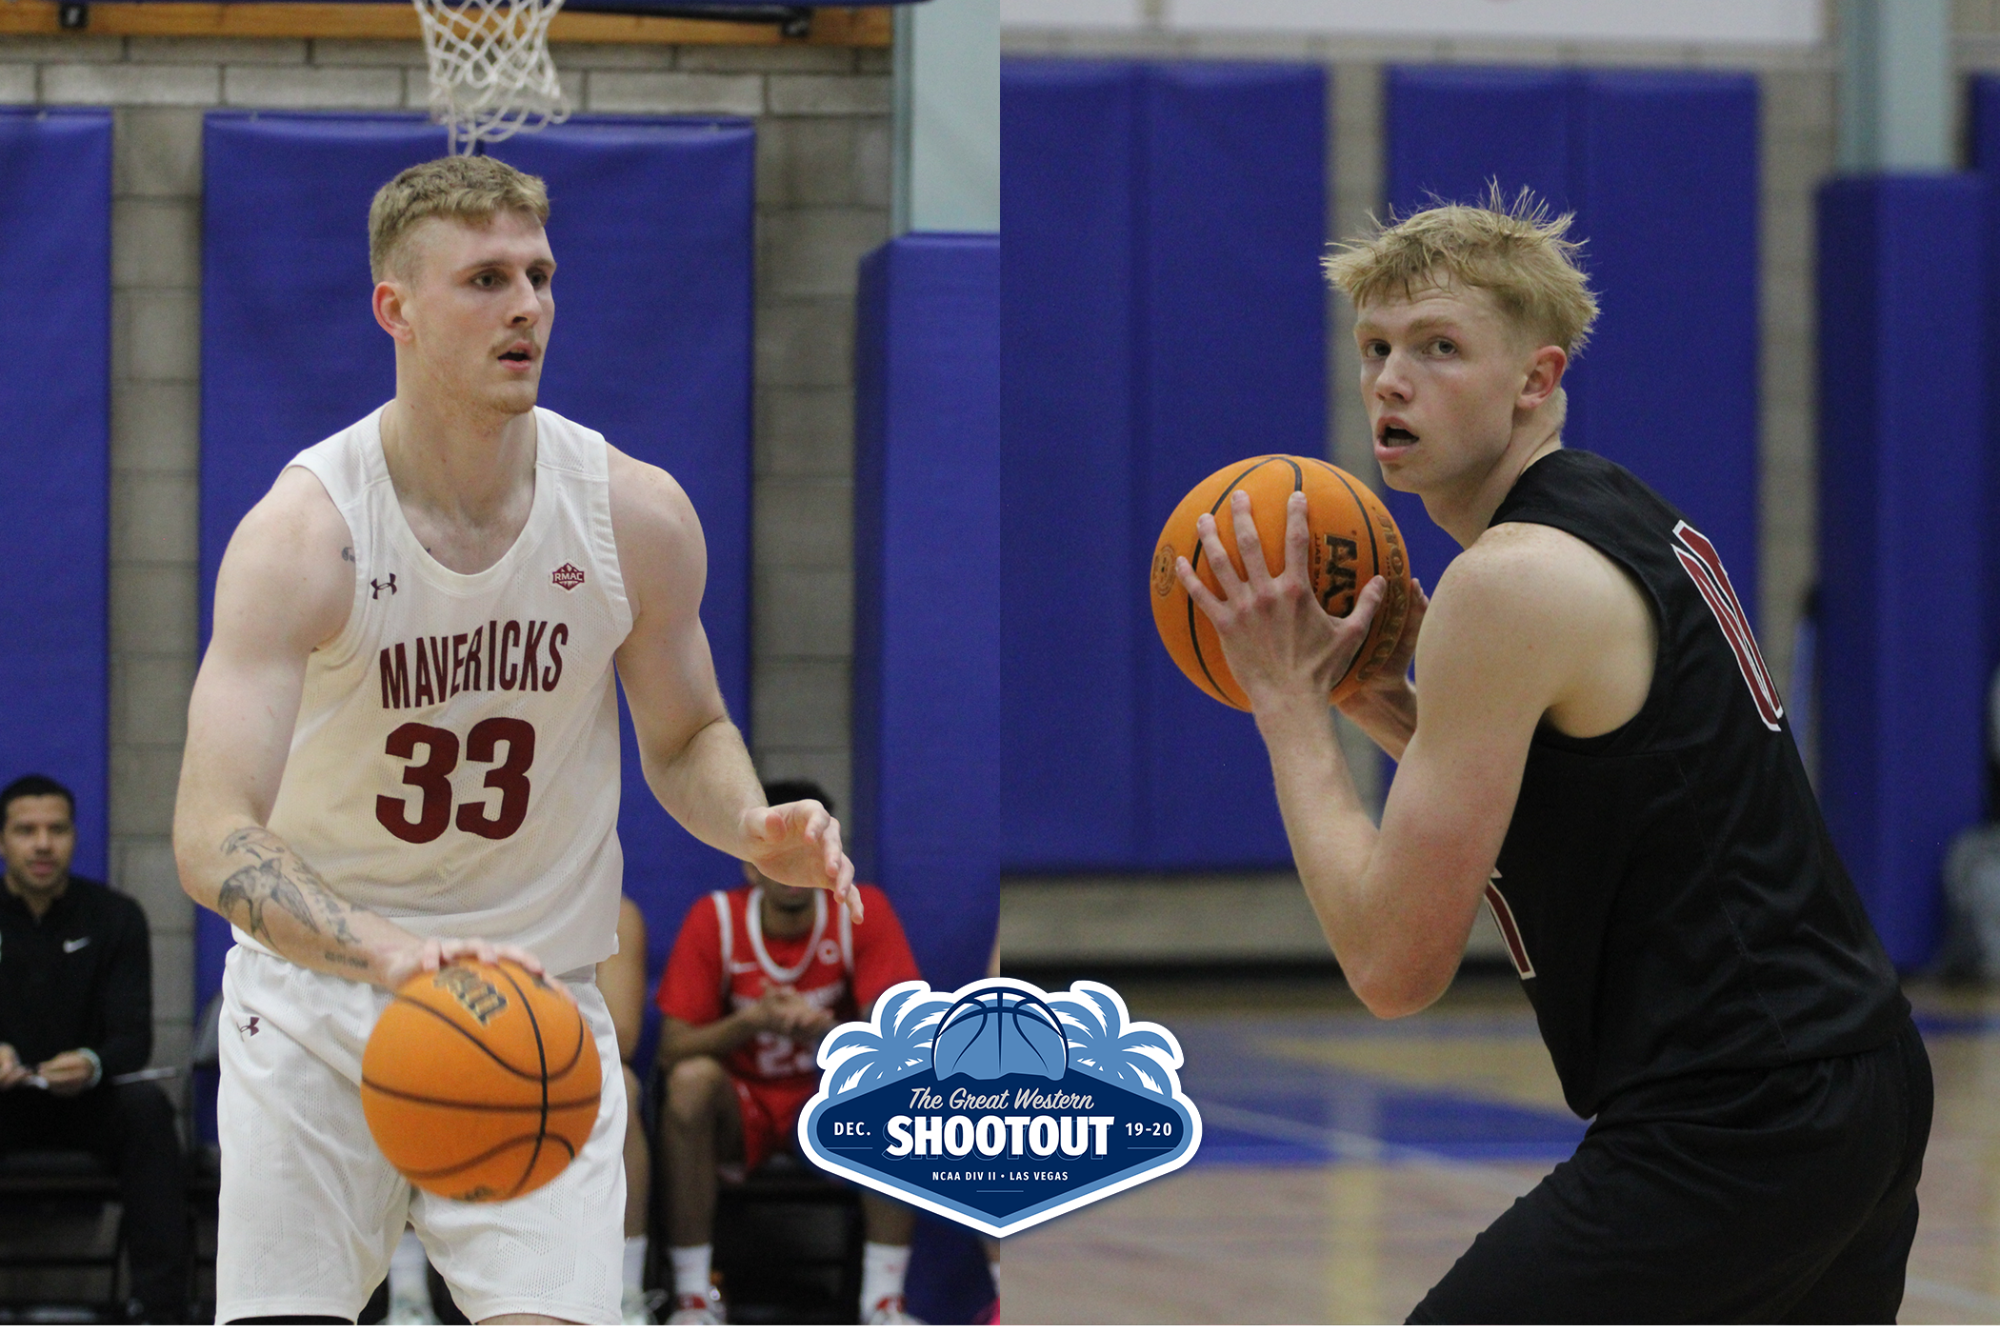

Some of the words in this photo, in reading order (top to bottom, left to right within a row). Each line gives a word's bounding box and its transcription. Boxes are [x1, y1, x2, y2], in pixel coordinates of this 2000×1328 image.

[554, 572, 583, 582] RMAC
[379, 619, 569, 709] MAVERICKS
[375, 716, 536, 845] 33
